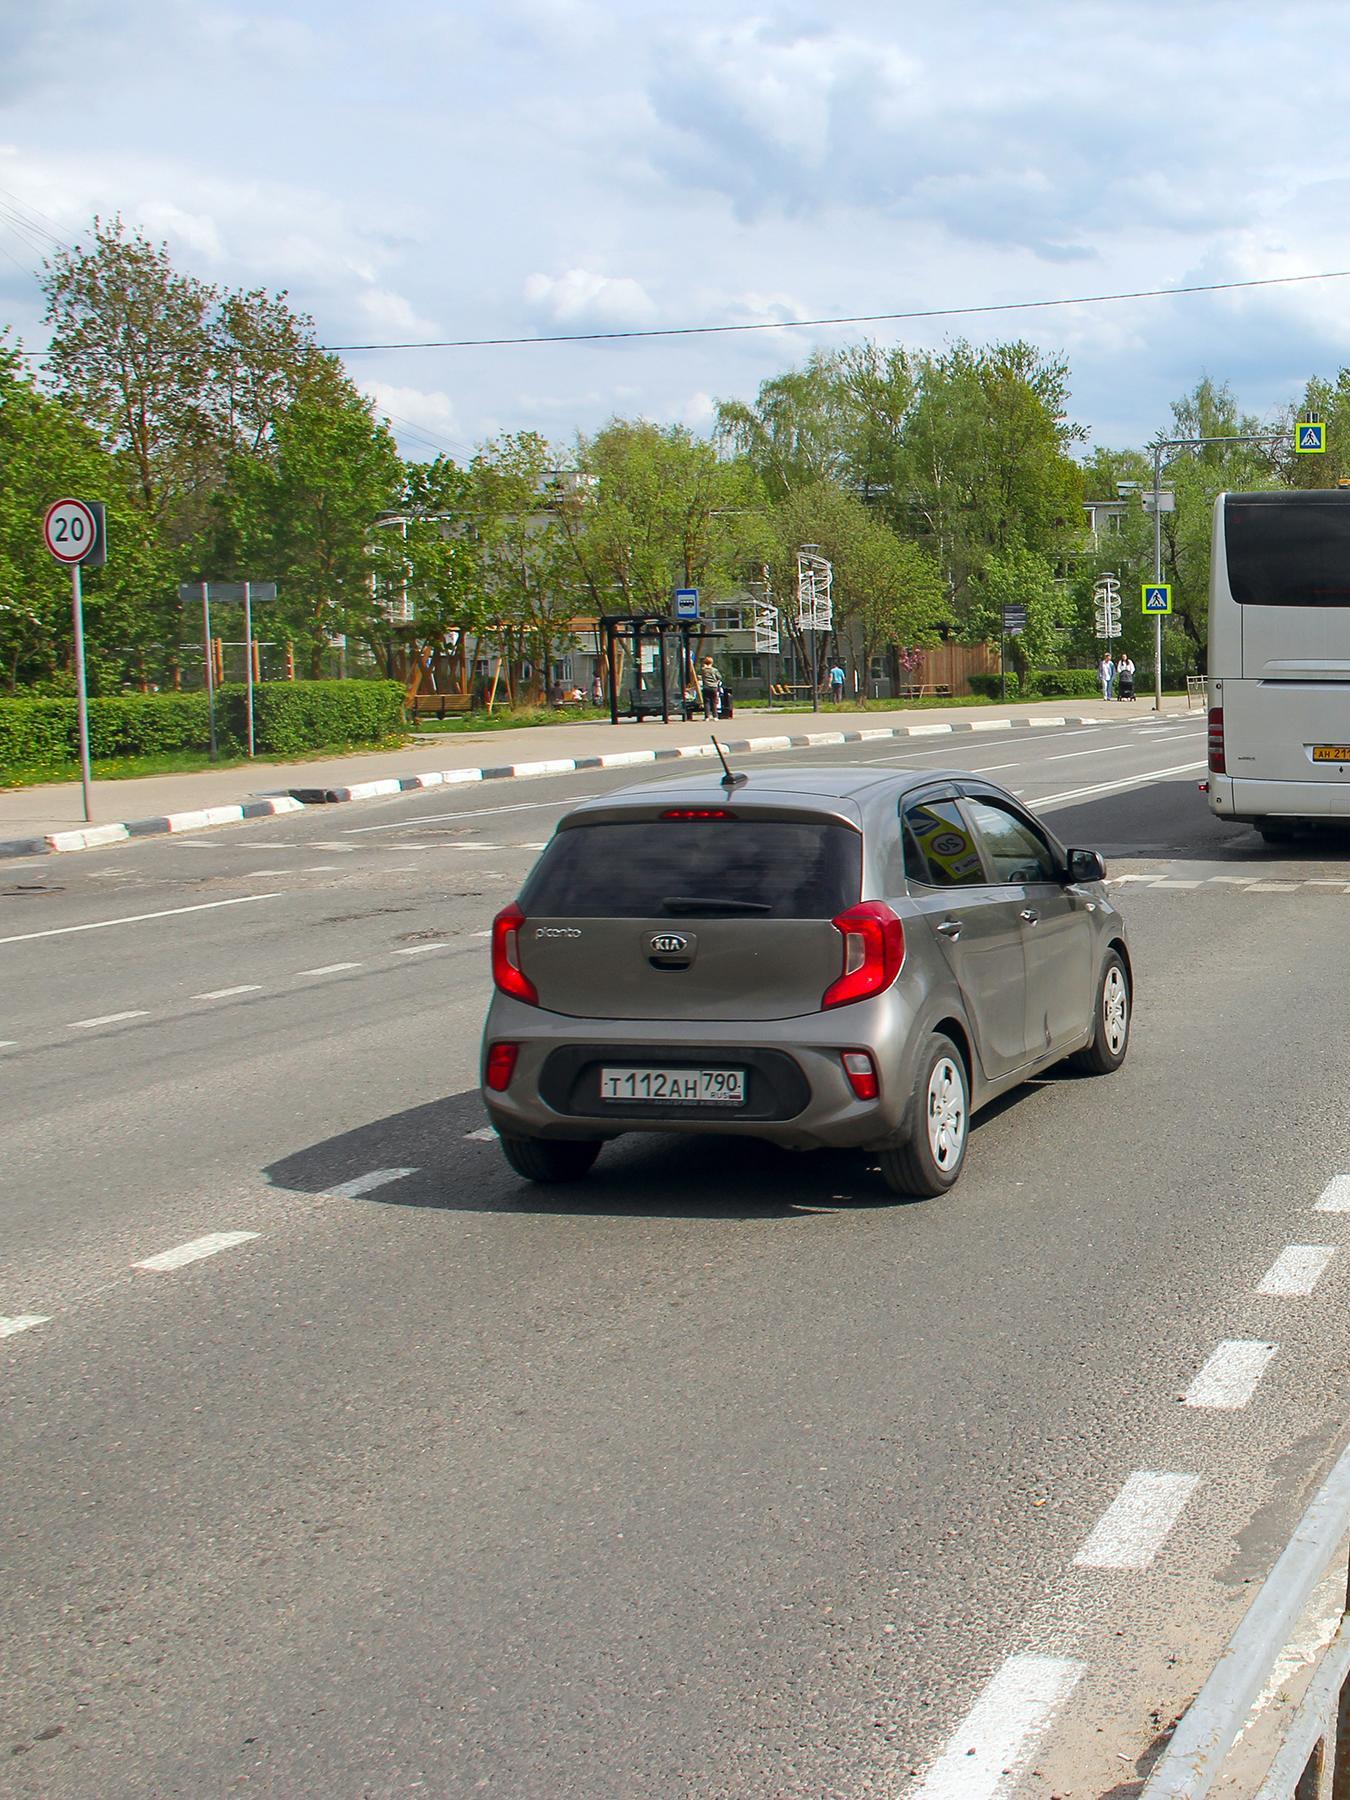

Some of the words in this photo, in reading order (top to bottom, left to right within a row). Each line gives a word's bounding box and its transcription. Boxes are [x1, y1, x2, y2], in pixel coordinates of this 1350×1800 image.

[55, 517, 84, 542] 20
[655, 938, 681, 950] KIA
[703, 1072, 739, 1092] 790
[710, 1091, 730, 1100] RUS
